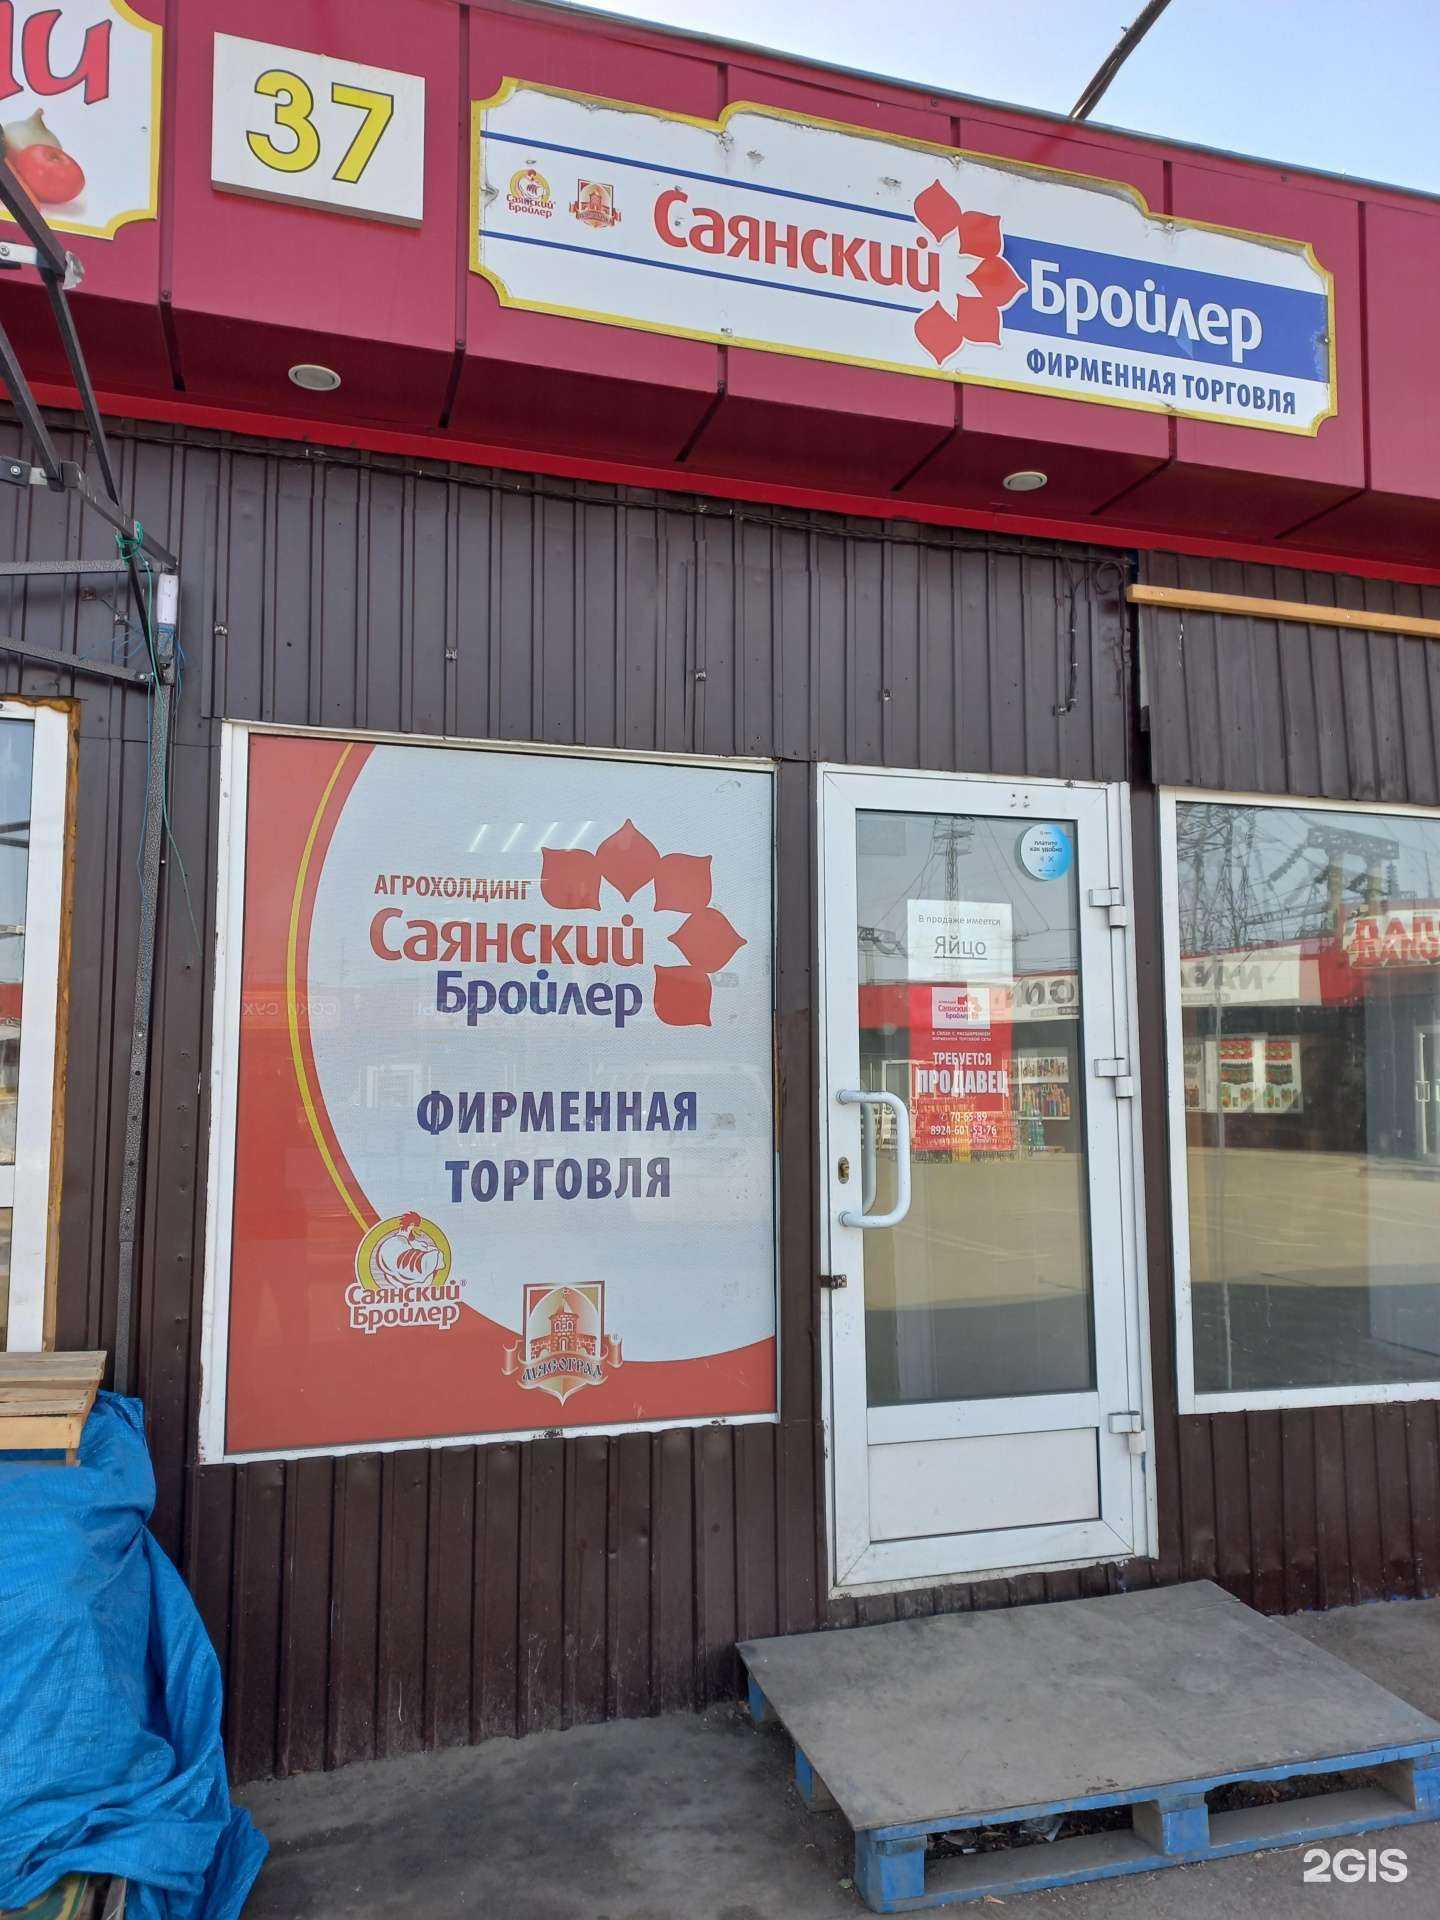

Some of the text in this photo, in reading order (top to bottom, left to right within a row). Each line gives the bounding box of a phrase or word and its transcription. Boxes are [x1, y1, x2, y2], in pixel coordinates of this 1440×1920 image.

[246, 69, 394, 184] 37
[508, 201, 553, 219] Бройлер
[653, 187, 940, 294] Саянский
[1030, 257, 1263, 364] Бройлер
[1026, 348, 1297, 415] ФИРМЕННАЯ ТОРГОВЛЯ
[374, 874, 531, 902] АГРОХОЛДИНГ
[369, 907, 644, 966] Саянский
[926, 915, 965, 925] продаже
[966, 917, 1001, 926] имеется
[934, 935, 986, 958] Яйцо
[437, 969, 643, 1028] Бройлер
[933, 1052, 992, 1066] ТРЕБУЕТСЯ
[918, 1070, 1009, 1097] ПРОДАВЕЦ
[416, 1090, 697, 1135] ФИРМЕННАЯ
[445, 1157, 671, 1203] ТОРГОВЛЯ
[347, 1280, 460, 1305] Саянский
[353, 1302, 457, 1331] Бройлер
